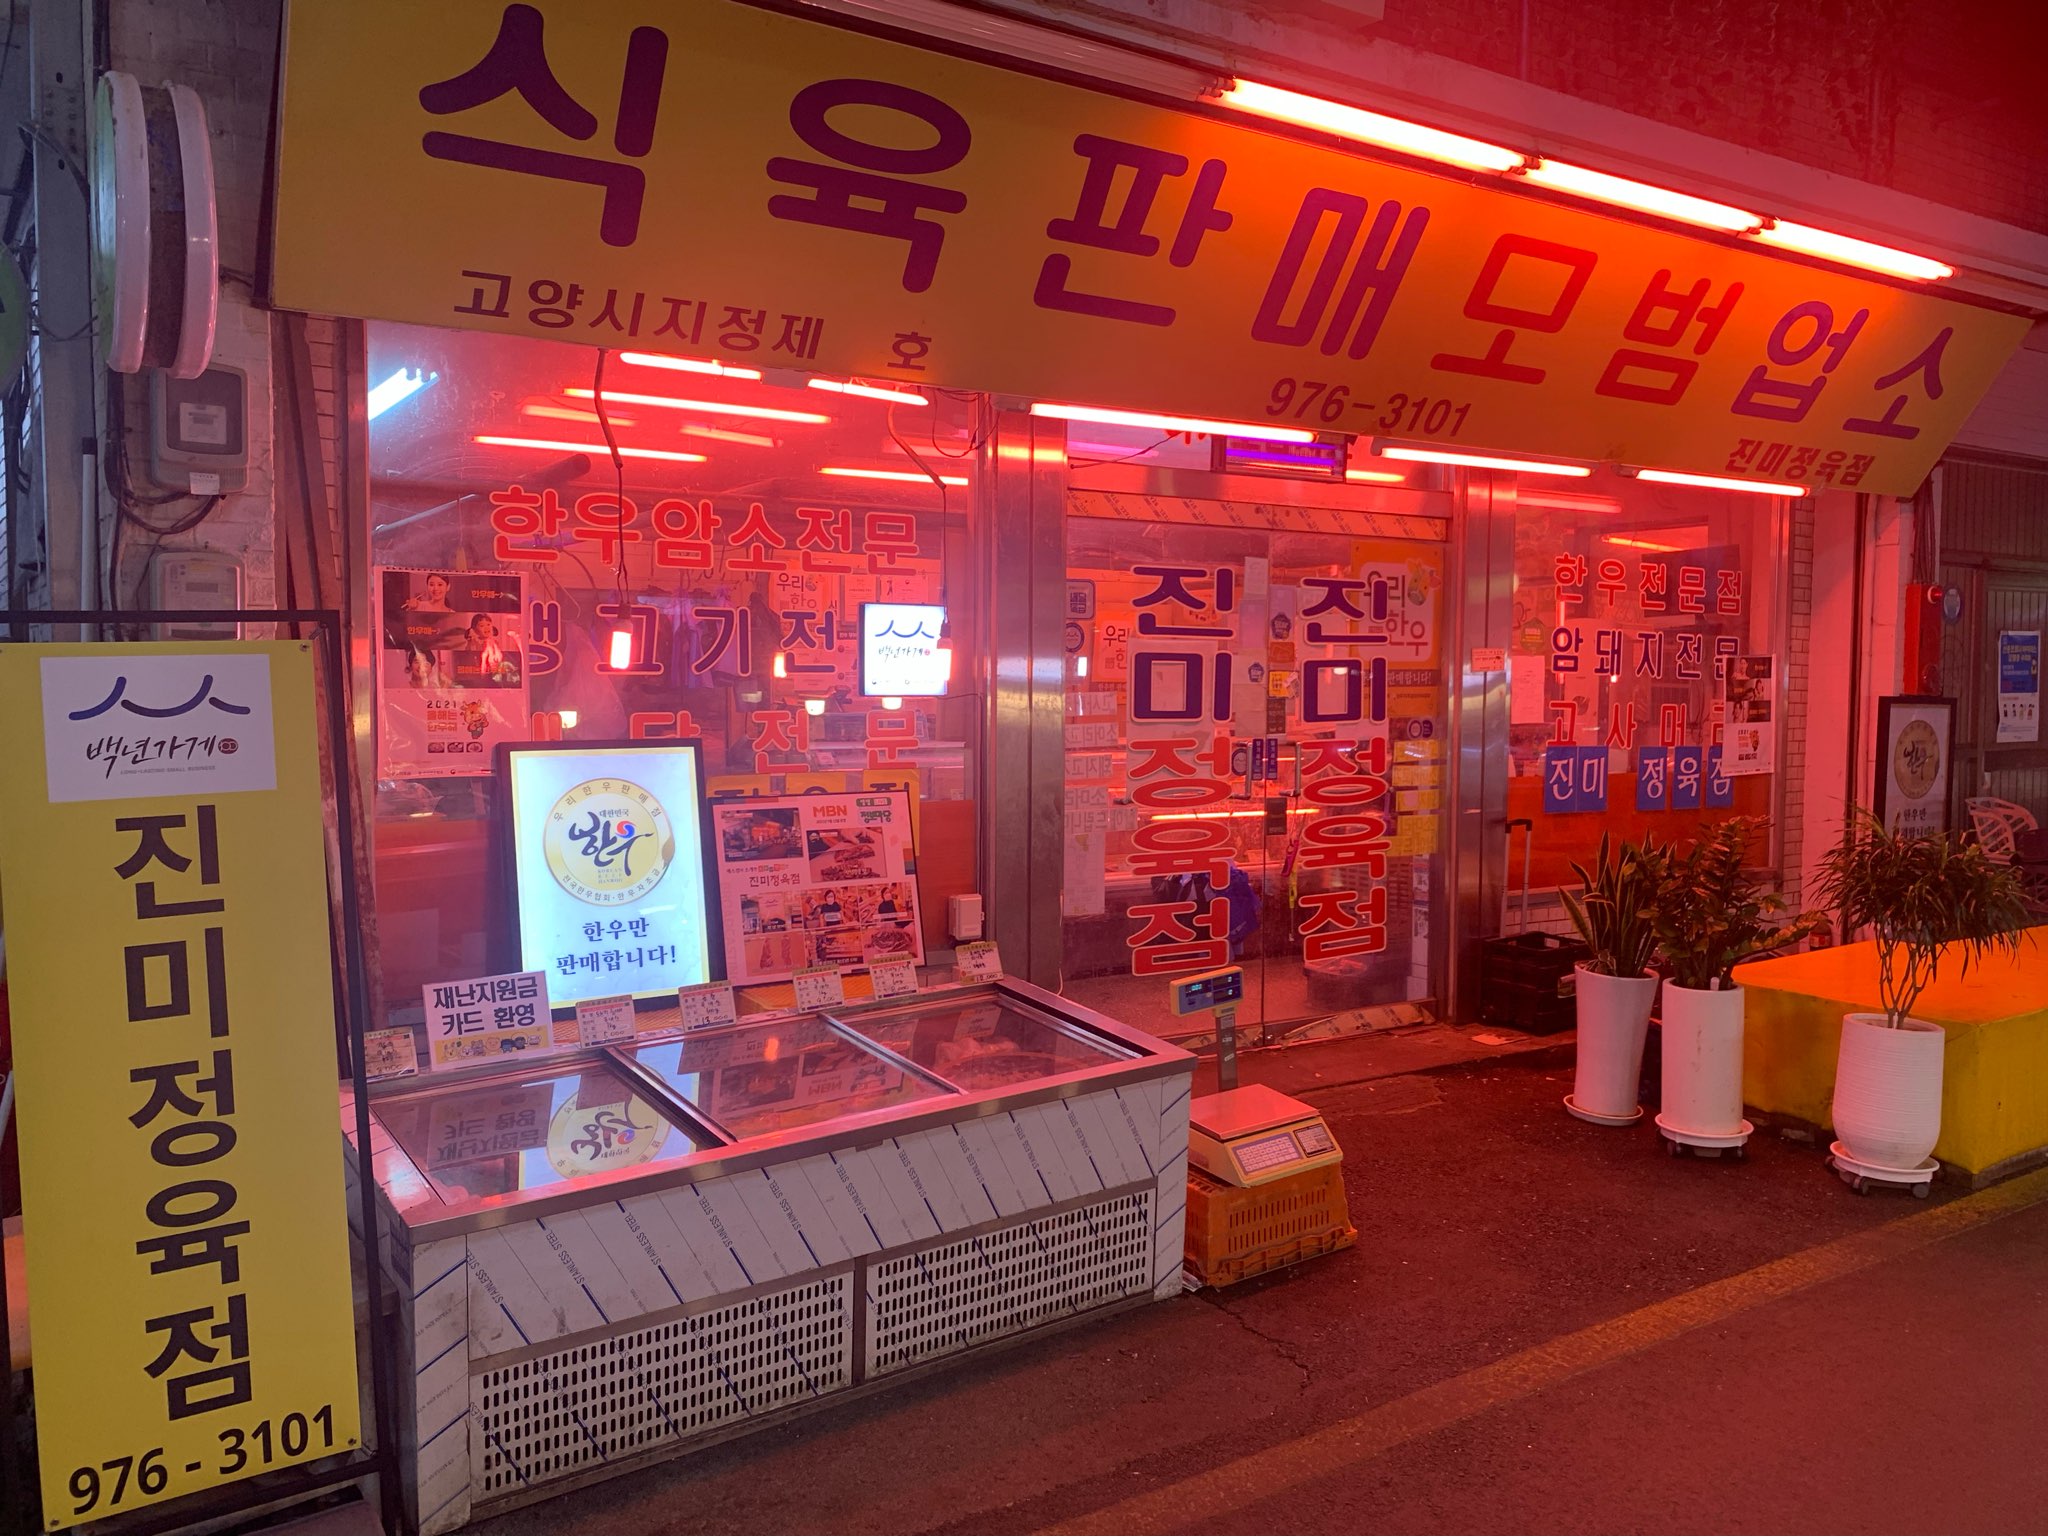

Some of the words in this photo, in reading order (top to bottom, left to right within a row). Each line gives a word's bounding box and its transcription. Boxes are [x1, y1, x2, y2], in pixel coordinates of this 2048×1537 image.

[453, 269, 822, 360] 고양시지정제
[887, 330, 933, 372] 호
[1266, 377, 1471, 437] 976-3101
[1725, 437, 1875, 488] 진미정육점
[489, 484, 920, 577] 한우암소전문
[1554, 551, 1743, 617] 한우전문점
[427, 700, 457, 709] 2021
[86, 735, 218, 779] 백년가게
[1126, 565, 1237, 976] 진미정육점
[1298, 576, 1392, 963] 진미정육점
[1548, 757, 1606, 801] 진미
[599, 808, 630, 818] 대한민국
[813, 804, 848, 818] MBN
[749, 873, 801, 888] 진미정육점
[582, 917, 650, 942] 한우만
[556, 945, 676, 976] 판매합니다!
[432, 976, 538, 1010] 재난지원금
[442, 1011, 485, 1036] 카드
[493, 1003, 536, 1030] 환영
[114, 805, 251, 1421] 진미정육점
[898, 1148, 911, 1168] STEEL
[957, 1138, 971, 1157] STEEL
[836, 1164, 850, 1184] STEEL
[907, 1167, 926, 1198] STAINLESS
[967, 1152, 985, 1184] STAINLESS
[698, 1195, 714, 1216] STEEL
[768, 1179, 784, 1200] STEEL
[844, 1183, 866, 1214] STAINLESS
[625, 1211, 639, 1233] STEEL
[779, 1199, 802, 1231] STAINLESS
[545, 1229, 562, 1251] STEEL
[709, 1215, 734, 1249] STAINLESS
[636, 1232, 662, 1267] STAINLESS
[558, 1250, 585, 1285] STAINLESS
[475, 1269, 504, 1304] STAINLESS
[69, 1447, 169, 1515] 976
[218, 1405, 335, 1476] 3101
